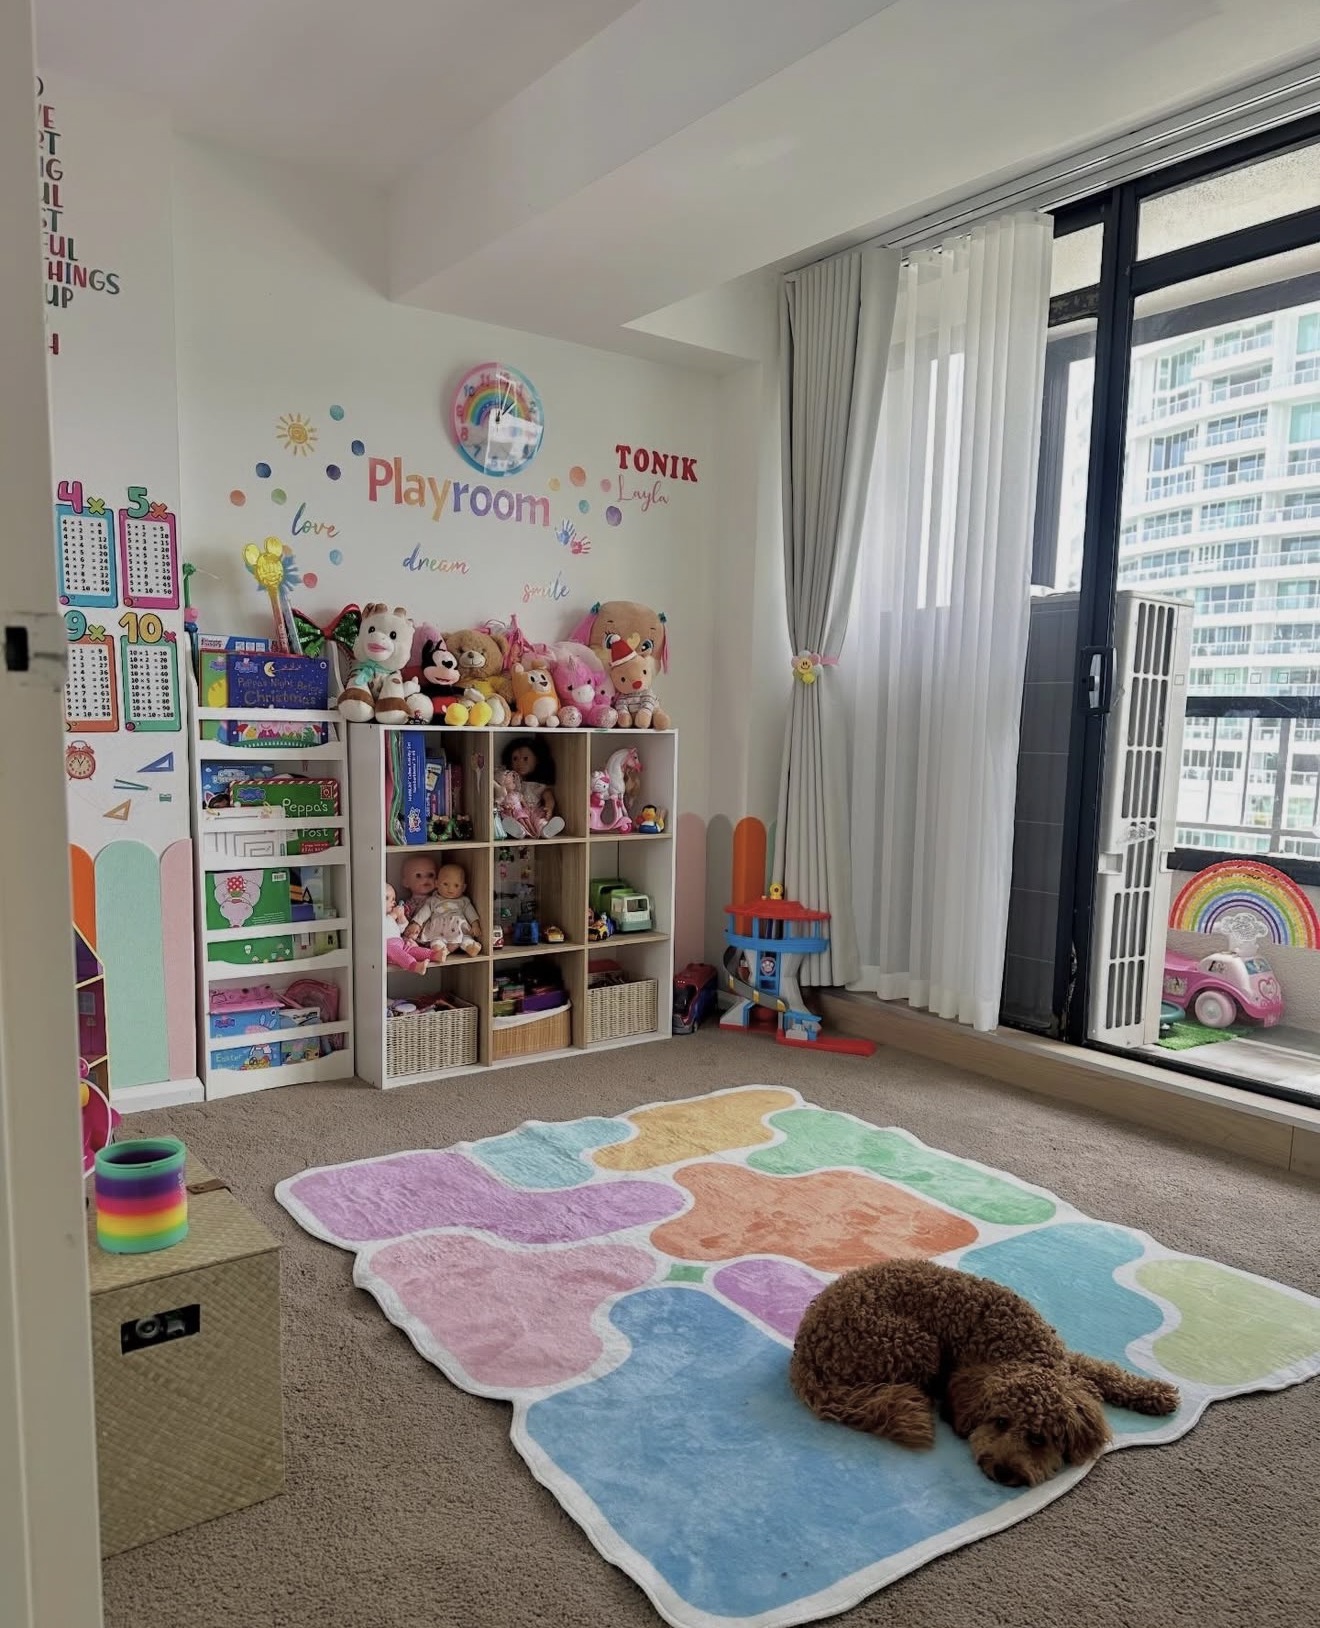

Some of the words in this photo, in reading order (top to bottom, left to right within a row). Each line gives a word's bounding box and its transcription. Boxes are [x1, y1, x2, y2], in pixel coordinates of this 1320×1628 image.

[42, 232, 78, 261] UL
[44, 257, 120, 295] HINGS
[615, 444, 698, 482] TONIK
[368, 457, 550, 527] Playroom
[616, 473, 671, 512] Layla
[291, 502, 341, 538] love
[402, 542, 470, 575] dream
[523, 570, 570, 603] smile
[282, 798, 329, 816] Peppa's
